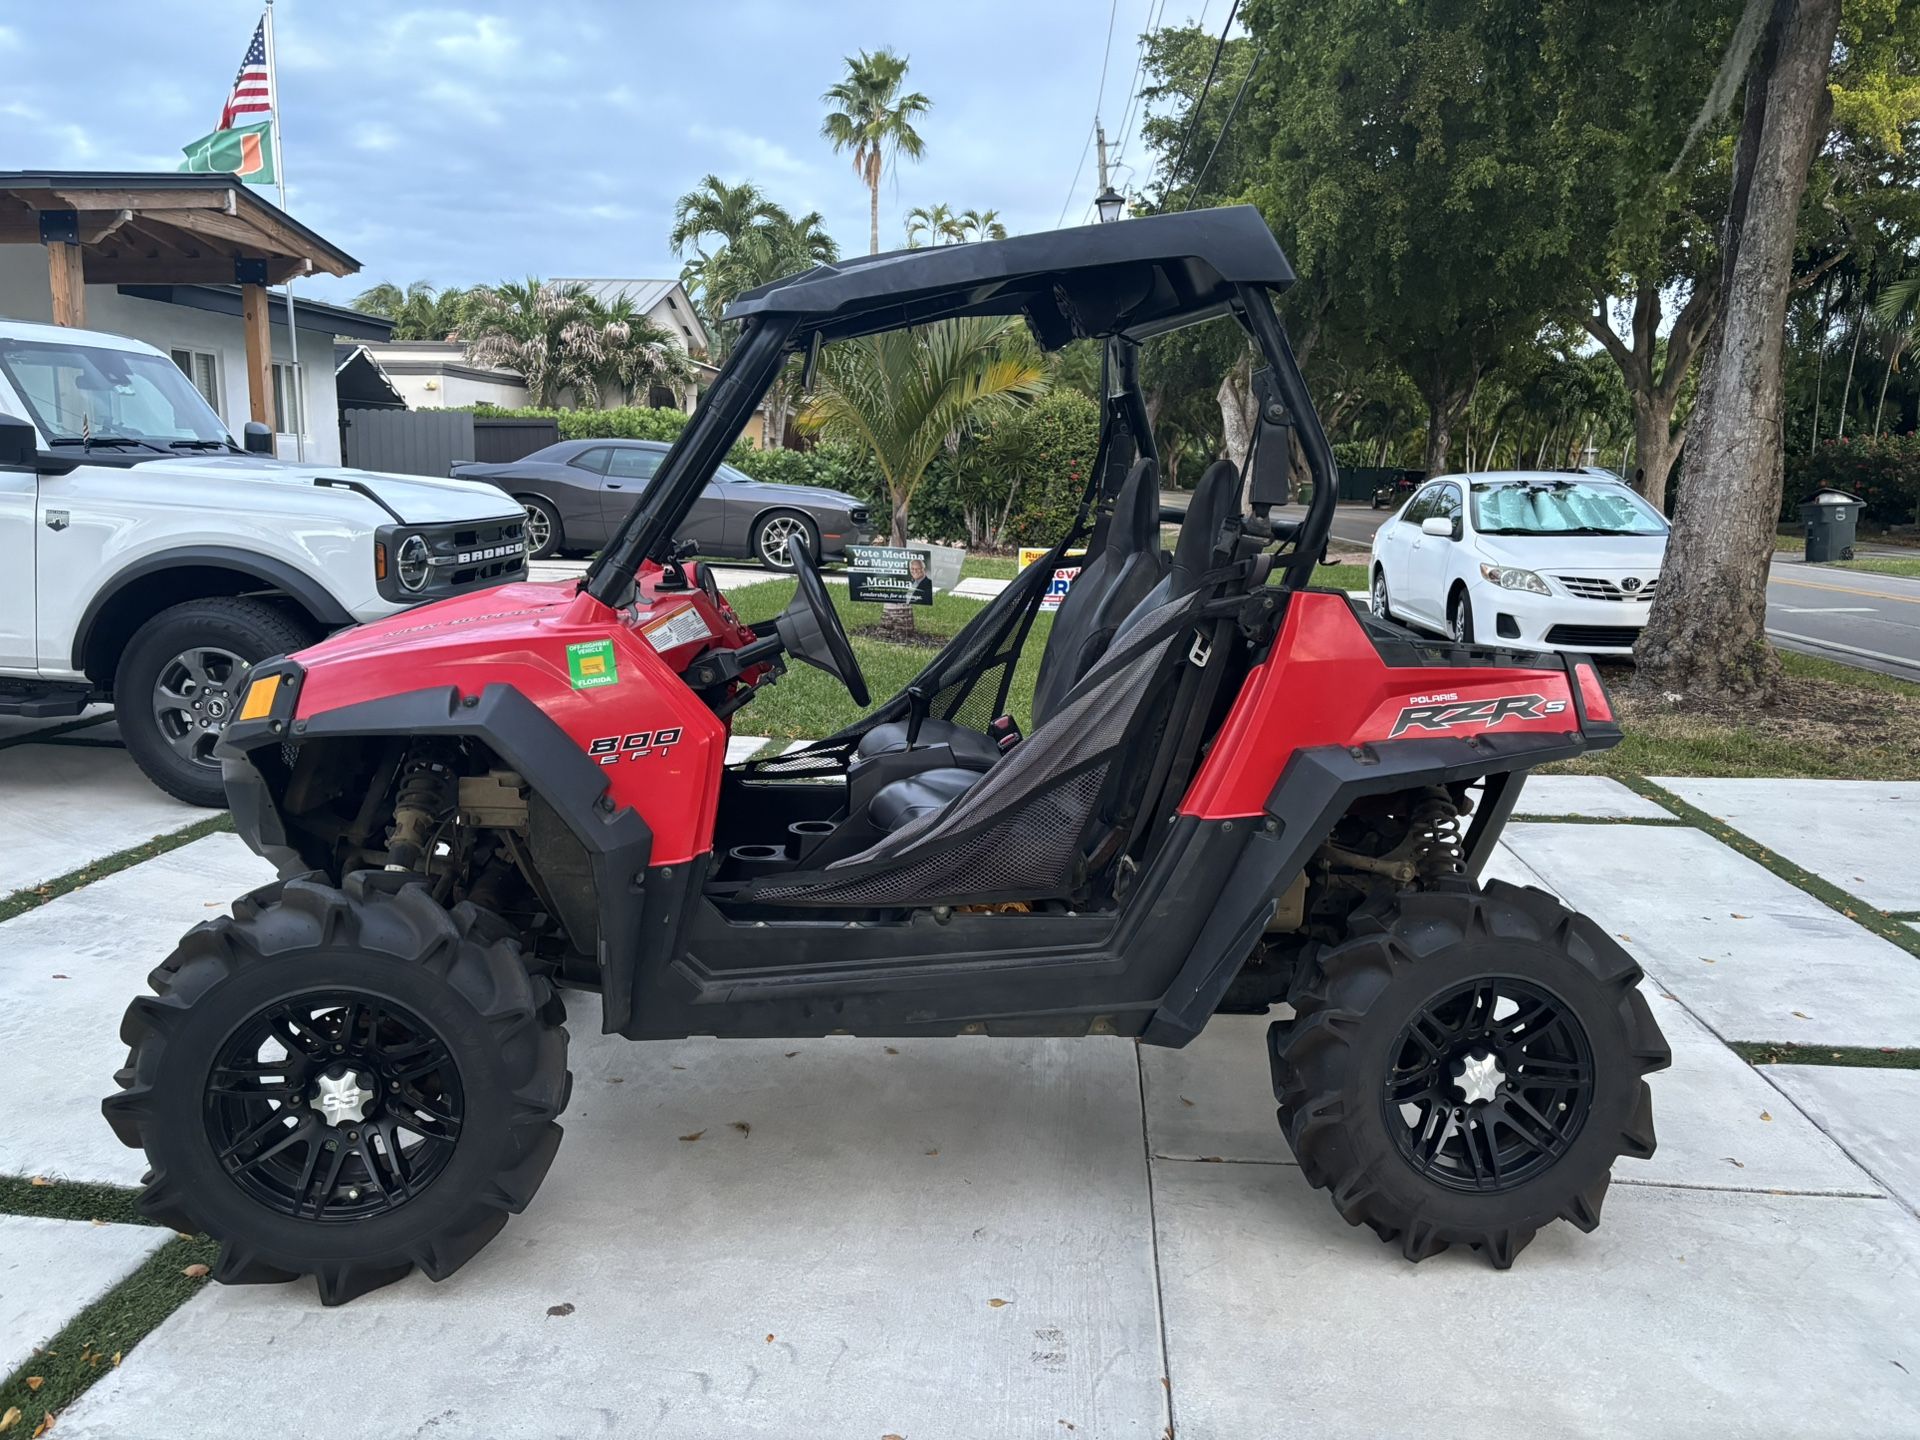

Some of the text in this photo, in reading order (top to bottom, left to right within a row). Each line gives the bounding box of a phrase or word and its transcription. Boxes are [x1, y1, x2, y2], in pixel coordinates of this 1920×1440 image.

[458, 543, 523, 564] BRONCO
[853, 549, 880, 558] Vote
[882, 550, 925, 560] Medina
[854, 557, 909, 569] for Mayor!
[866, 576, 913, 589] Medina
[578, 676, 612, 688] FLORIDA
[1409, 693, 1458, 704] POLARIS
[1388, 694, 1547, 739] RZR
[587, 727, 683, 756] 800
[599, 747, 669, 765] EFI
